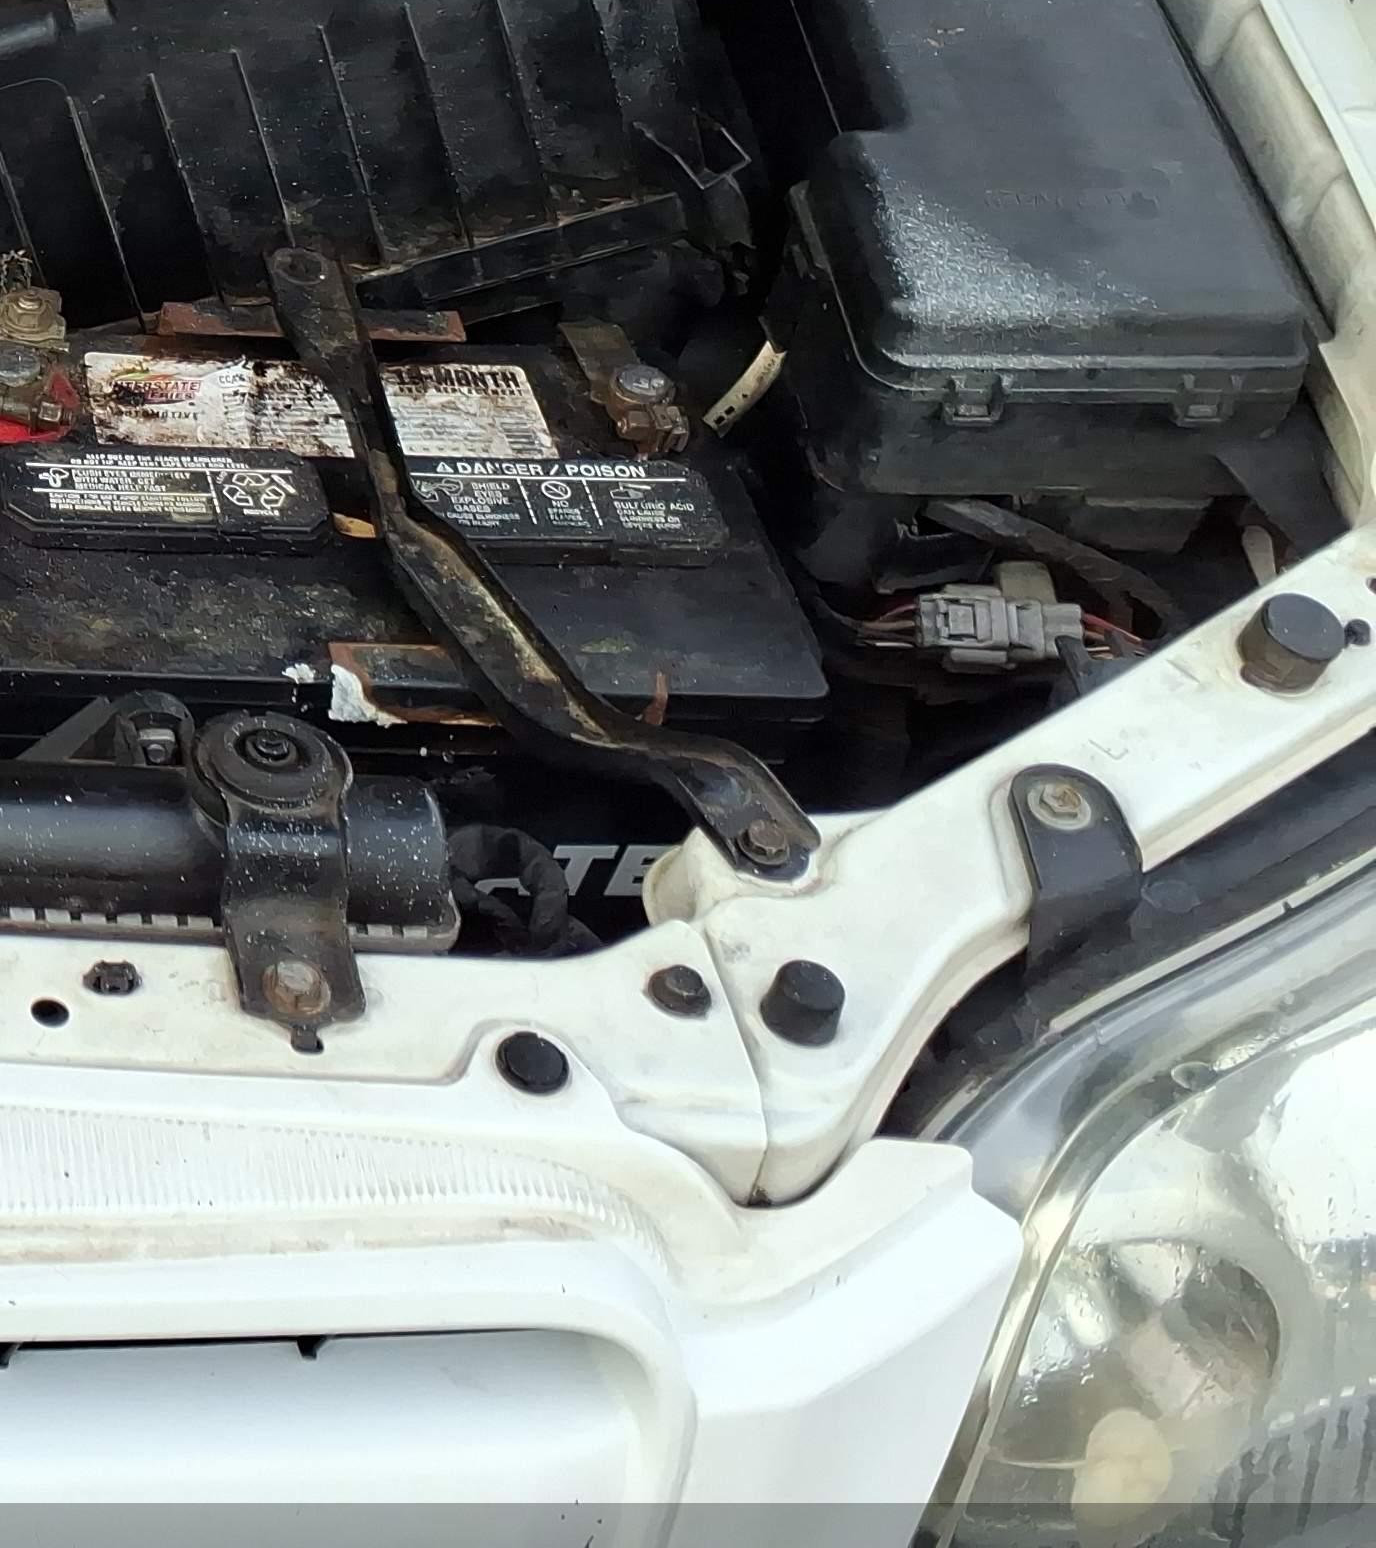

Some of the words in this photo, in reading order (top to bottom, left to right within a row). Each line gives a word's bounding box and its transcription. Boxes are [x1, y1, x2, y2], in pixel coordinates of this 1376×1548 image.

[457, 461, 543, 477] DANGER
[565, 463, 646, 479] POISON
[451, 496, 510, 505] EXPLOSIVE
[551, 500, 569, 509] NO
[670, 502, 695, 512] ACID
